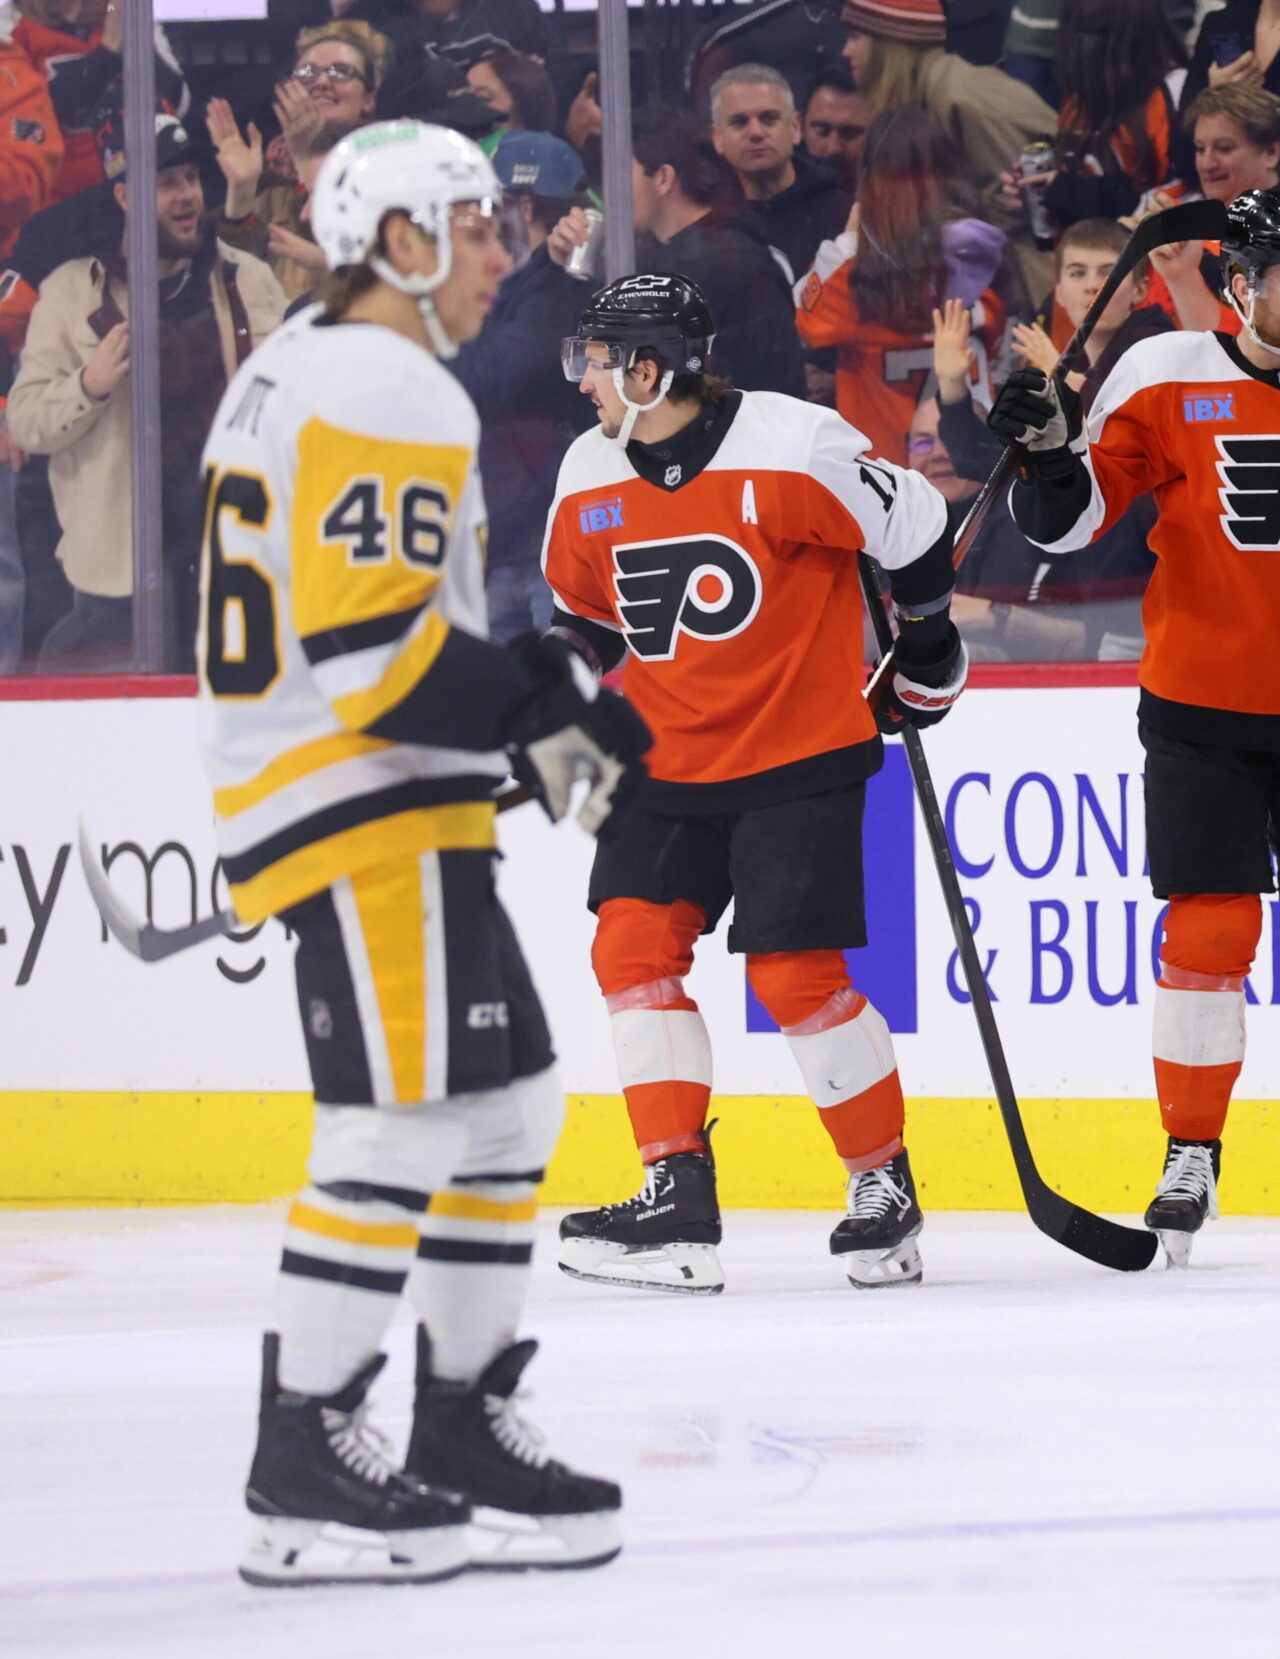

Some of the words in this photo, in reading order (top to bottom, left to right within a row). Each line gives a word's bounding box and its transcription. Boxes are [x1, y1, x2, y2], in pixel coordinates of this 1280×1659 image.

[617, 290, 671, 300] CHEVROLET
[1183, 400, 1236, 422] IBX
[579, 503, 625, 534] IBX
[741, 479, 759, 525] A
[320, 474, 452, 570] 46
[201, 463, 282, 700] 6
[946, 897, 1000, 1004] &
[635, 1203, 676, 1221] BAUER
